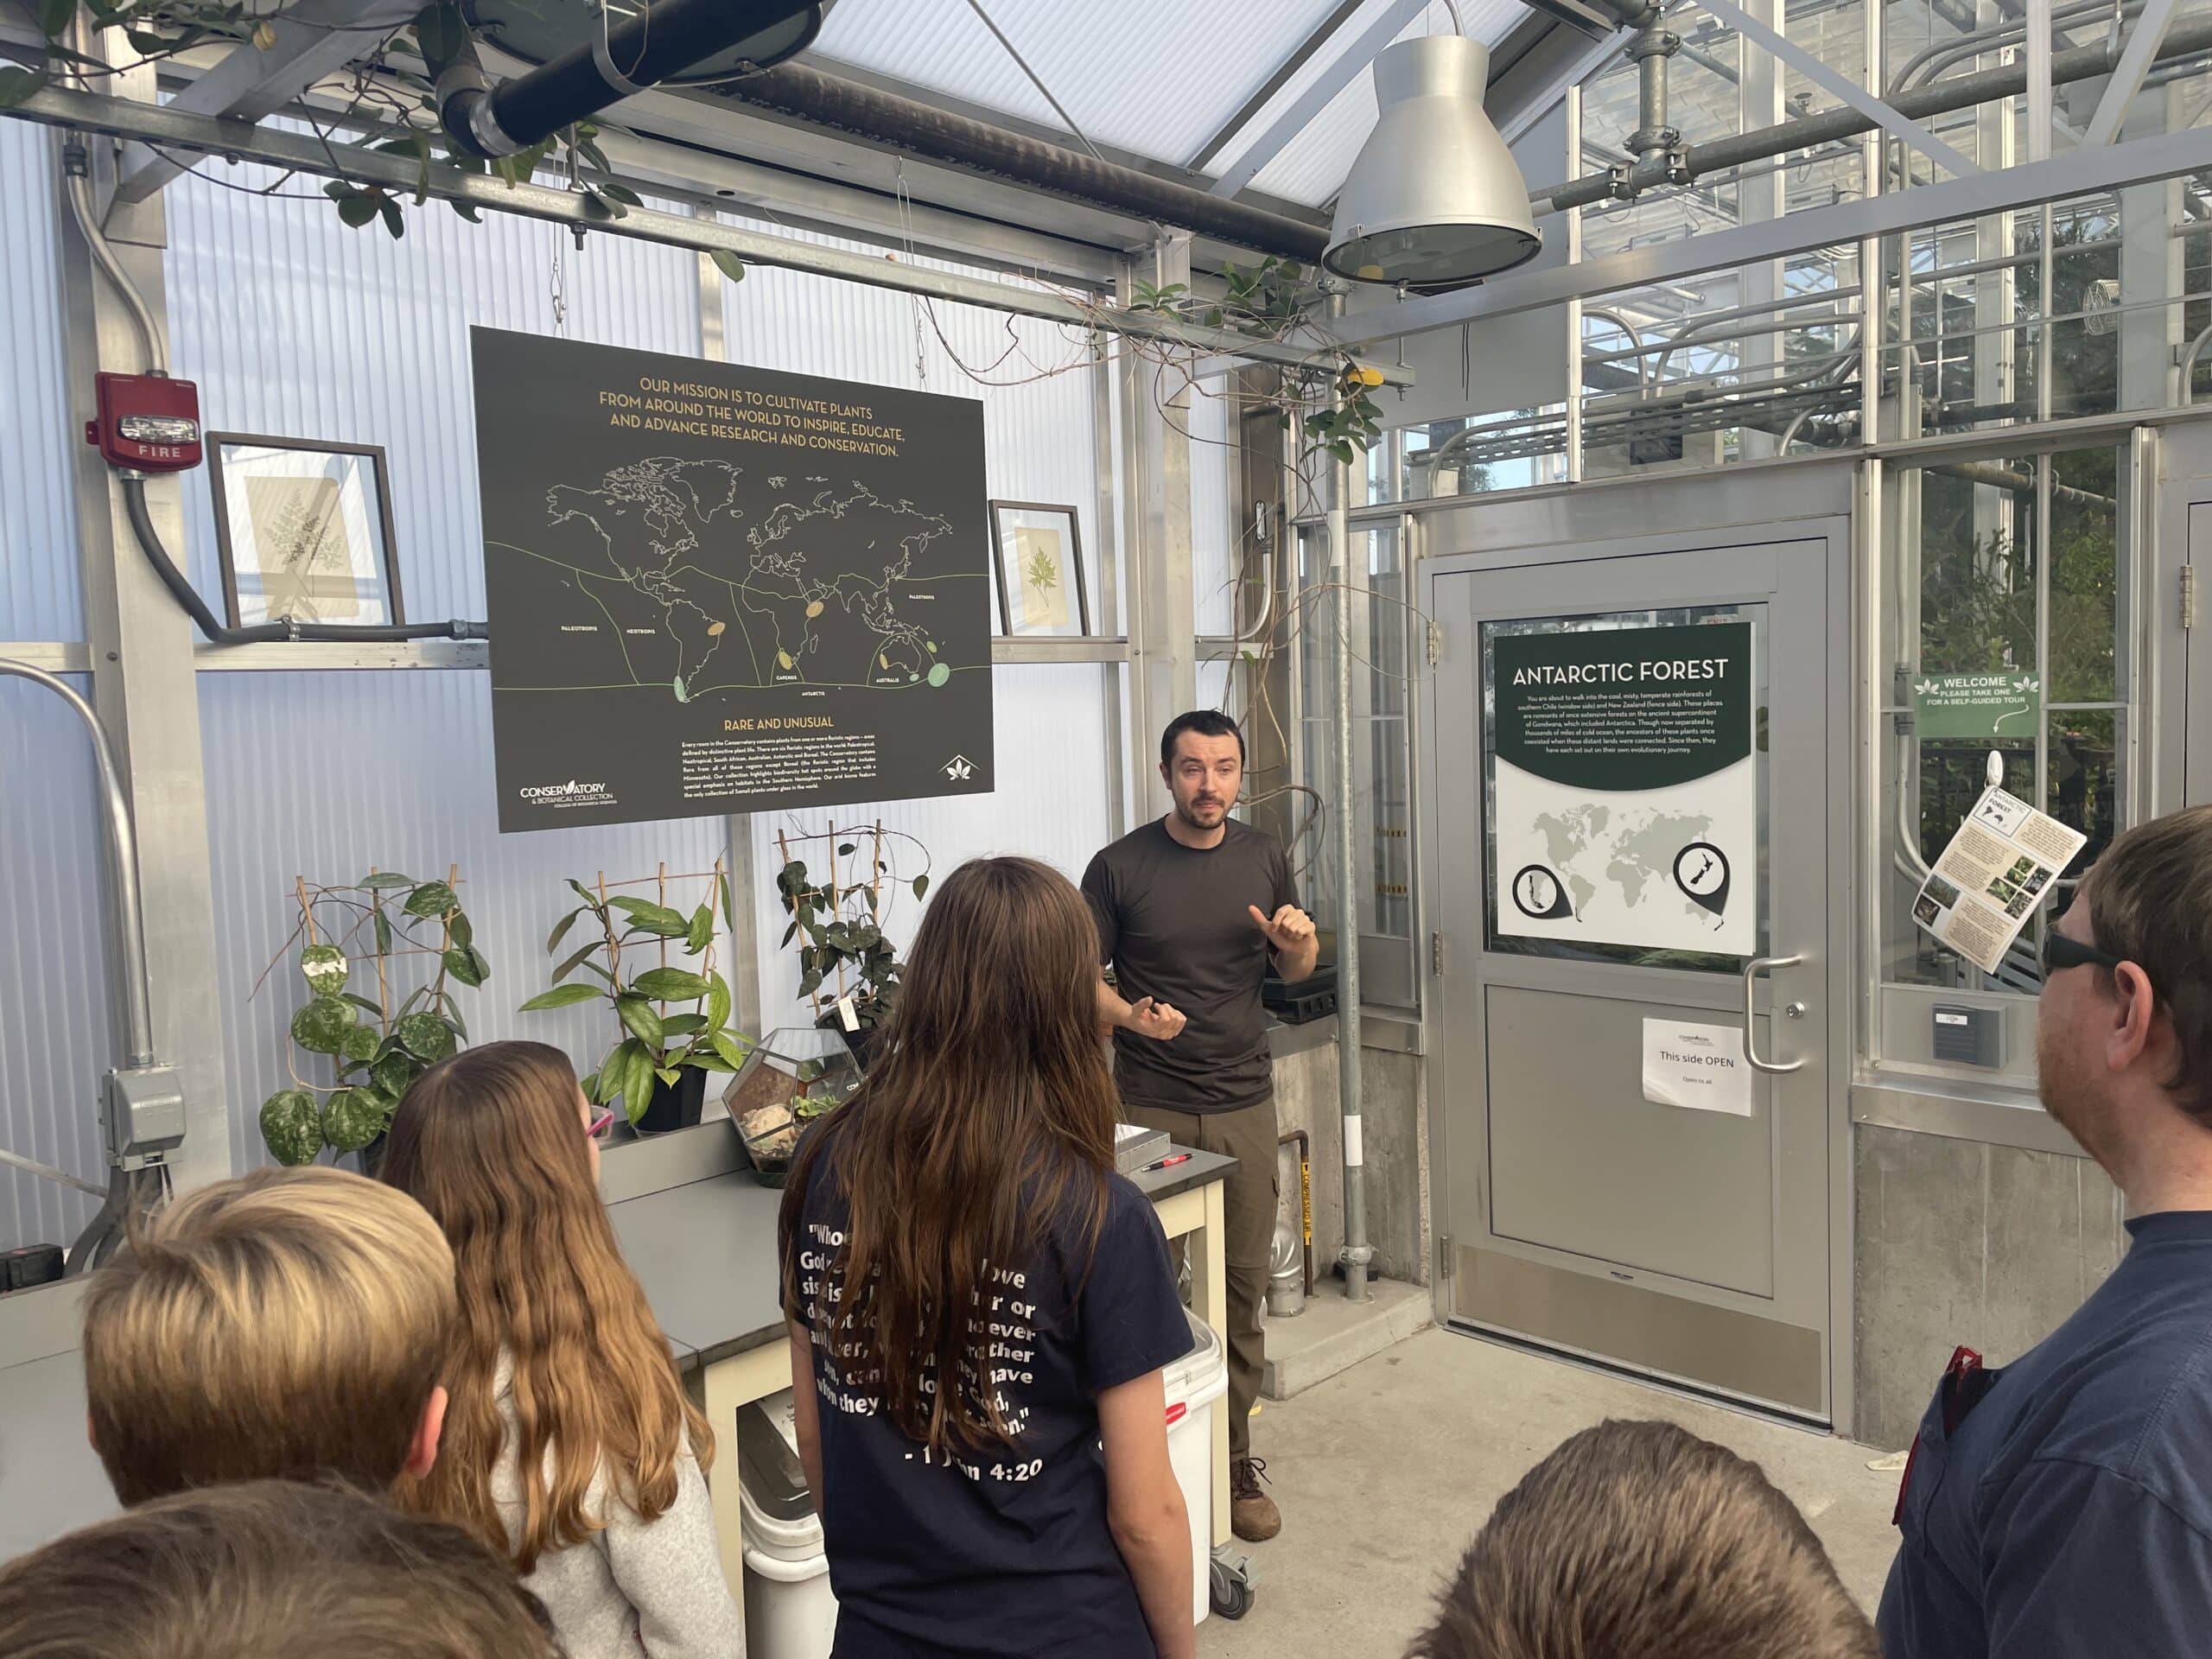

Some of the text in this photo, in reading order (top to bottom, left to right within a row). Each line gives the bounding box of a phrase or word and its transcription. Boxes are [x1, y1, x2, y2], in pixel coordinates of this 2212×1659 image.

[639, 378, 873, 420] OUR MISSION IS TO CULTIVATE PLANTS
[600, 391, 905, 442] FROM AROUND THE WORLD TO INSPIRE, EDUCATE,
[611, 413, 899, 457] AND ADVANCE RESEARCH AND CONSERVATION.
[138, 445, 181, 458] FIRE
[1513, 658, 1729, 685] ANTARCTIC FOREST
[1943, 677, 2006, 688] WELCOME
[724, 716, 835, 731] RARE AND UNUSUAL
[520, 779, 605, 798] CONSERVATORY
[1988, 798, 2012, 813] FOREST
[1660, 1051, 1734, 1068] This side OPEN
[1011, 1300, 1036, 1319] or
[839, 1394, 880, 1416] they
[990, 1459, 1044, 1482] 4:20
